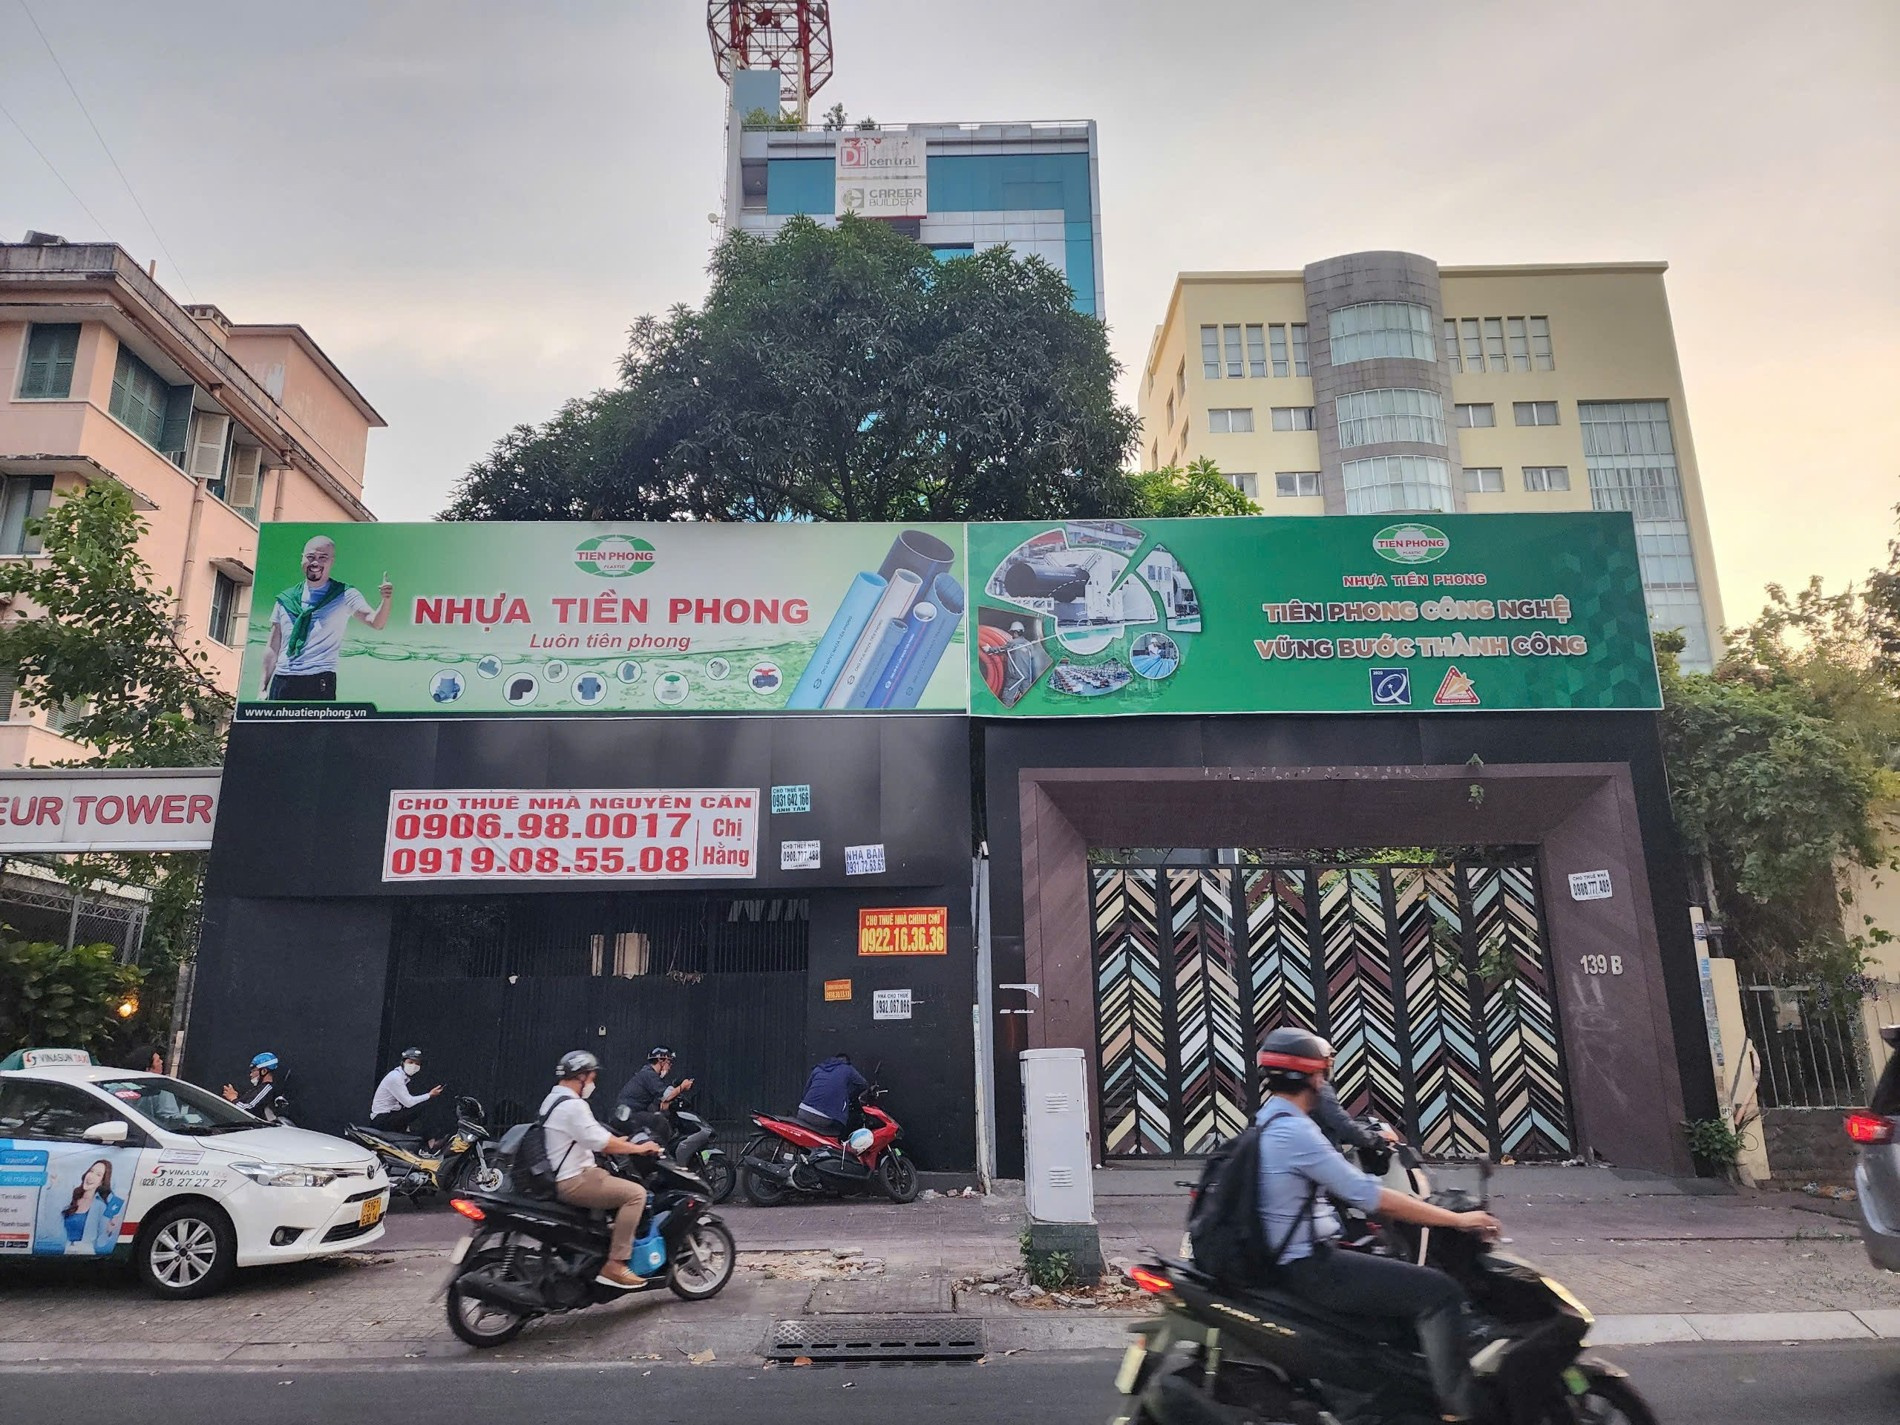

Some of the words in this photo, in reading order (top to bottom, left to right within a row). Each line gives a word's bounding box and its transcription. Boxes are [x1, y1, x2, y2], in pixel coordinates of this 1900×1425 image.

[869, 155, 916, 166] central
[869, 188, 922, 198] CAREER
[869, 198, 914, 207] BUILDER
[1378, 540, 1403, 548] TIEN
[577, 552, 606, 561] TIEN
[609, 552, 653, 561] PHONG
[1343, 573, 1387, 590] NHỰA
[1434, 574, 1486, 586] PHONG
[414, 592, 531, 632] NHỰA
[552, 588, 648, 624] TIỀN
[669, 598, 809, 624] PHONG
[1263, 599, 1324, 623] TIÊN
[1328, 600, 1418, 621] PHONG
[1421, 596, 1494, 620] CÔNG
[1498, 594, 1571, 624] NGHỆ
[529, 633, 581, 649] Luôn
[586, 633, 621, 649] tiên
[627, 633, 691, 652] phong
[1255, 635, 1333, 660] VỮNG
[1337, 633, 1416, 658] BƯỚC
[1416, 632, 1509, 657] THÀNH
[1512, 632, 1588, 656] CÔNG
[245, 707, 367, 719] www.nhuatienphong.vn
[73, 794, 214, 826] TOWER
[397, 797, 449, 810] CHO
[457, 795, 520, 810] THUÊ
[529, 795, 581, 810] NHÀ
[590, 793, 692, 809] NGUYÊN
[700, 793, 752, 809] CĂN
[394, 812, 692, 840] 0906.98.0017
[712, 817, 743, 842] Chị
[391, 846, 689, 875] 0919.08.55.08
[702, 840, 750, 868] Hằng
[847, 847, 864, 861] NHÀ
[866, 846, 883, 860] BÁN
[865, 914, 878, 926] CHO
[878, 912, 894, 925] THUÊ
[908, 912, 927, 925] CHÍNH
[861, 926, 944, 952] 0922.16.36.36
[1580, 954, 1607, 975] 139
[1610, 955, 1623, 975] B
[39, 1053, 73, 1062] VINASUN
[177, 1178, 192, 1187] 27
[194, 1178, 209, 1187] 27
[212, 1179, 227, 1188] 27
